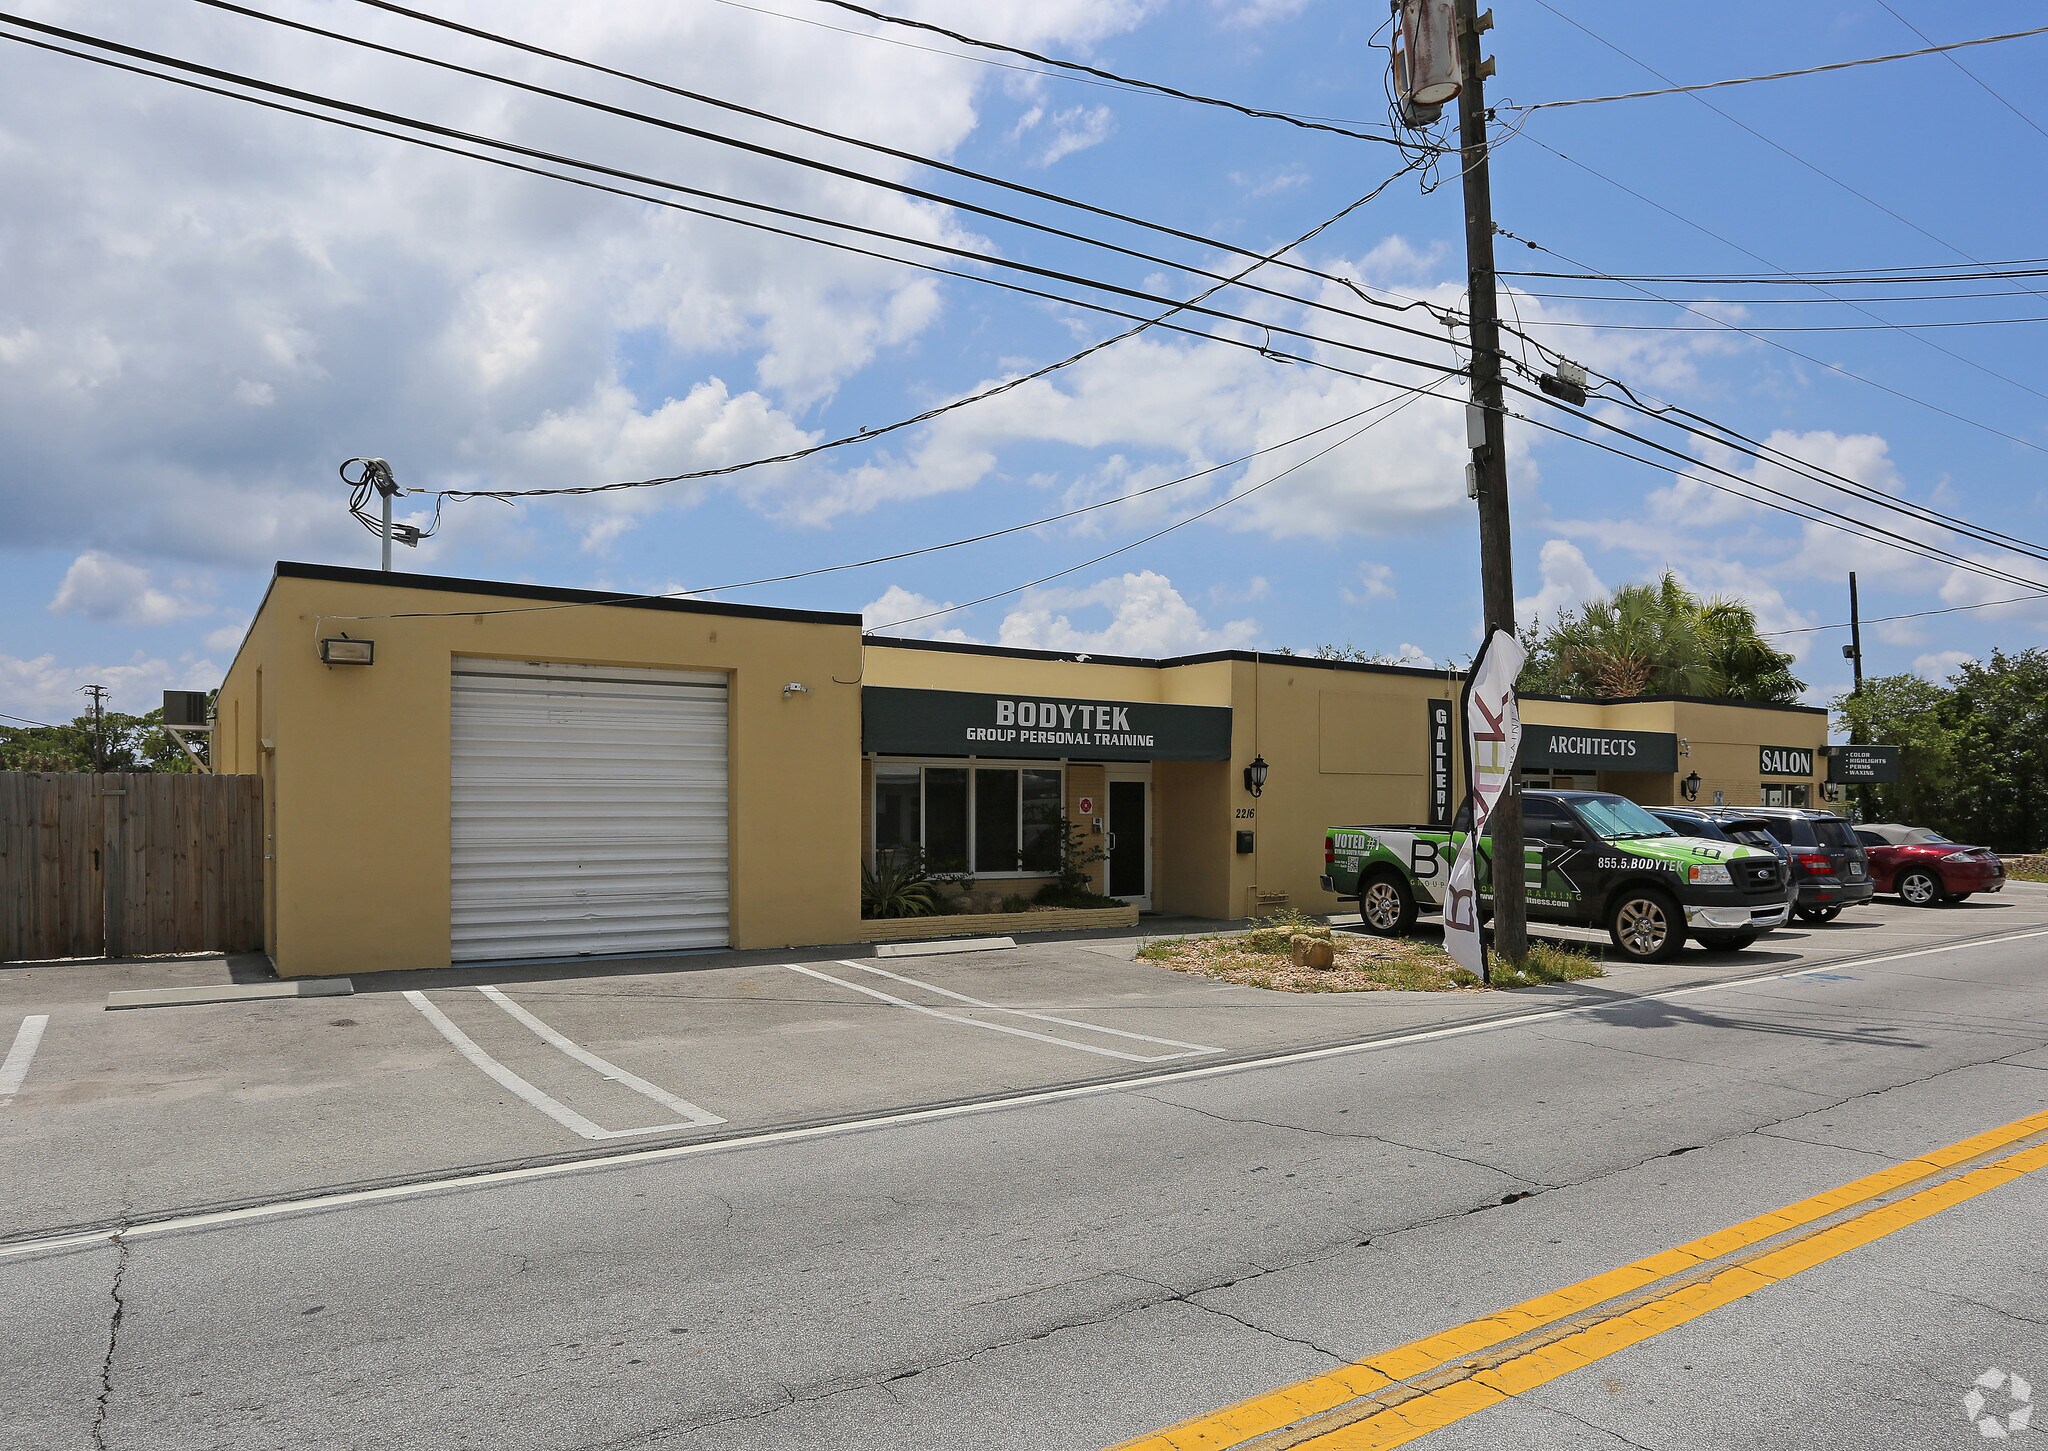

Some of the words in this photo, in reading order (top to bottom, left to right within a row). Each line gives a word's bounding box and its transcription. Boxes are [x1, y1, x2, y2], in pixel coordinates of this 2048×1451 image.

[996, 700, 1130, 731] BODYTEK
[966, 727, 1016, 742] GROUP
[1020, 730, 1091, 745] PERSONAL
[1094, 733, 1154, 747] TRAINING
[1549, 736, 1636, 756] ARCHITECTS
[1436, 709, 1447, 820] GALLERY
[1762, 750, 1810, 774] SALON
[1236, 808, 1255, 819] 2216
[1334, 833, 1365, 850] VOTED
[1366, 836, 1381, 851] #1
[1598, 857, 1685, 872] 855.5.BODYTEK
[1526, 889, 1582, 901] RAINING
